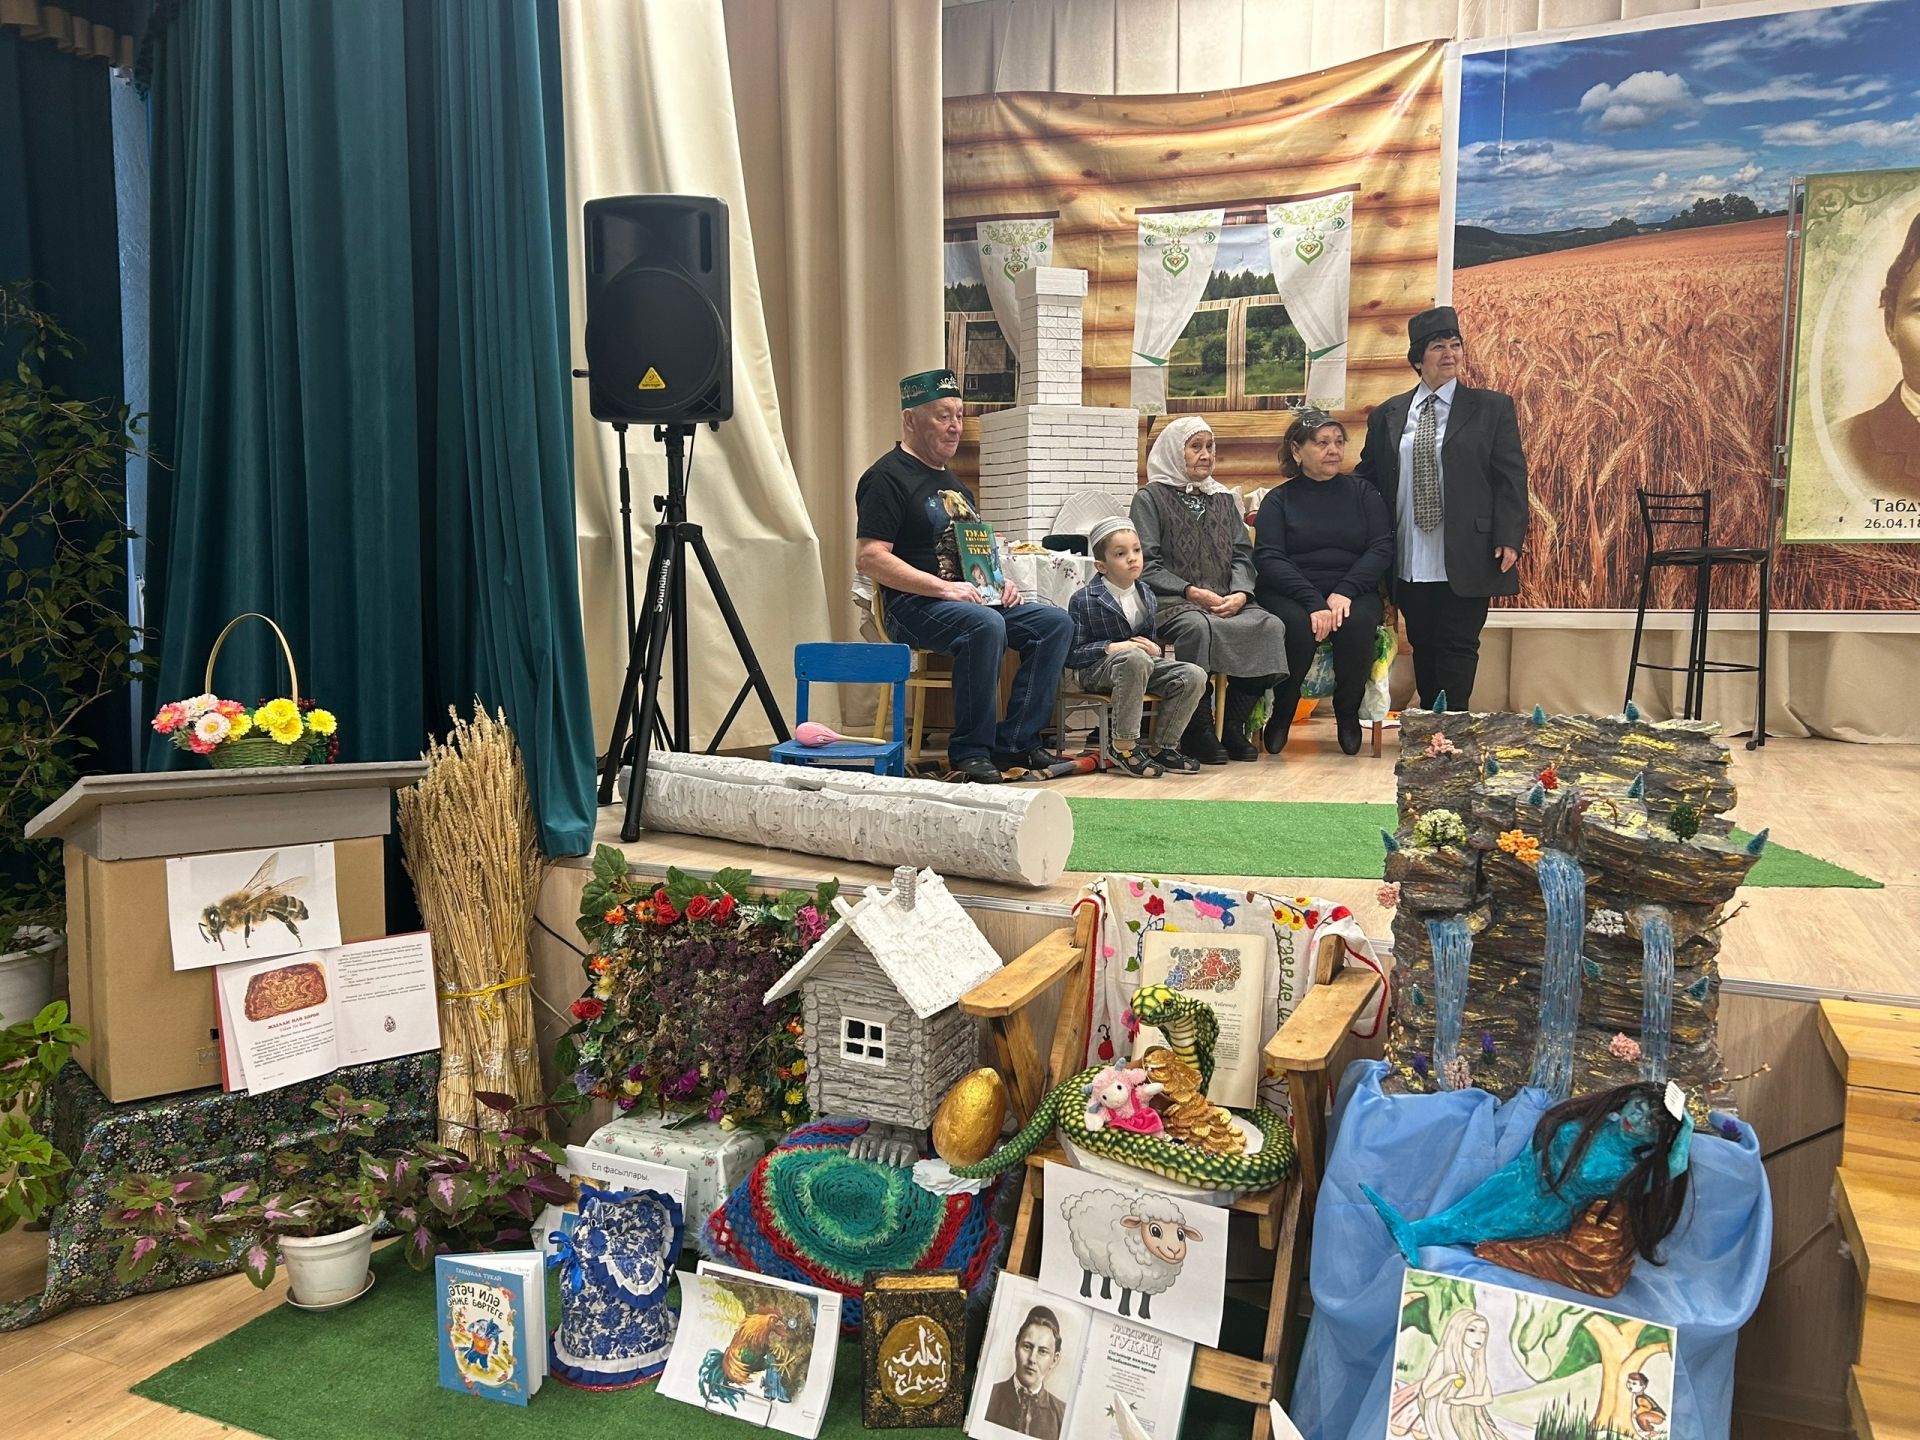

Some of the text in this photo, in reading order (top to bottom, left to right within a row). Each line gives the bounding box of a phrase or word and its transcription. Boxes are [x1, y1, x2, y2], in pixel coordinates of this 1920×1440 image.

[653, 559, 671, 613] Soundking
[592, 1163, 602, 1171] Ел
[1110, 1333, 1162, 1361] ТУКАЙ
